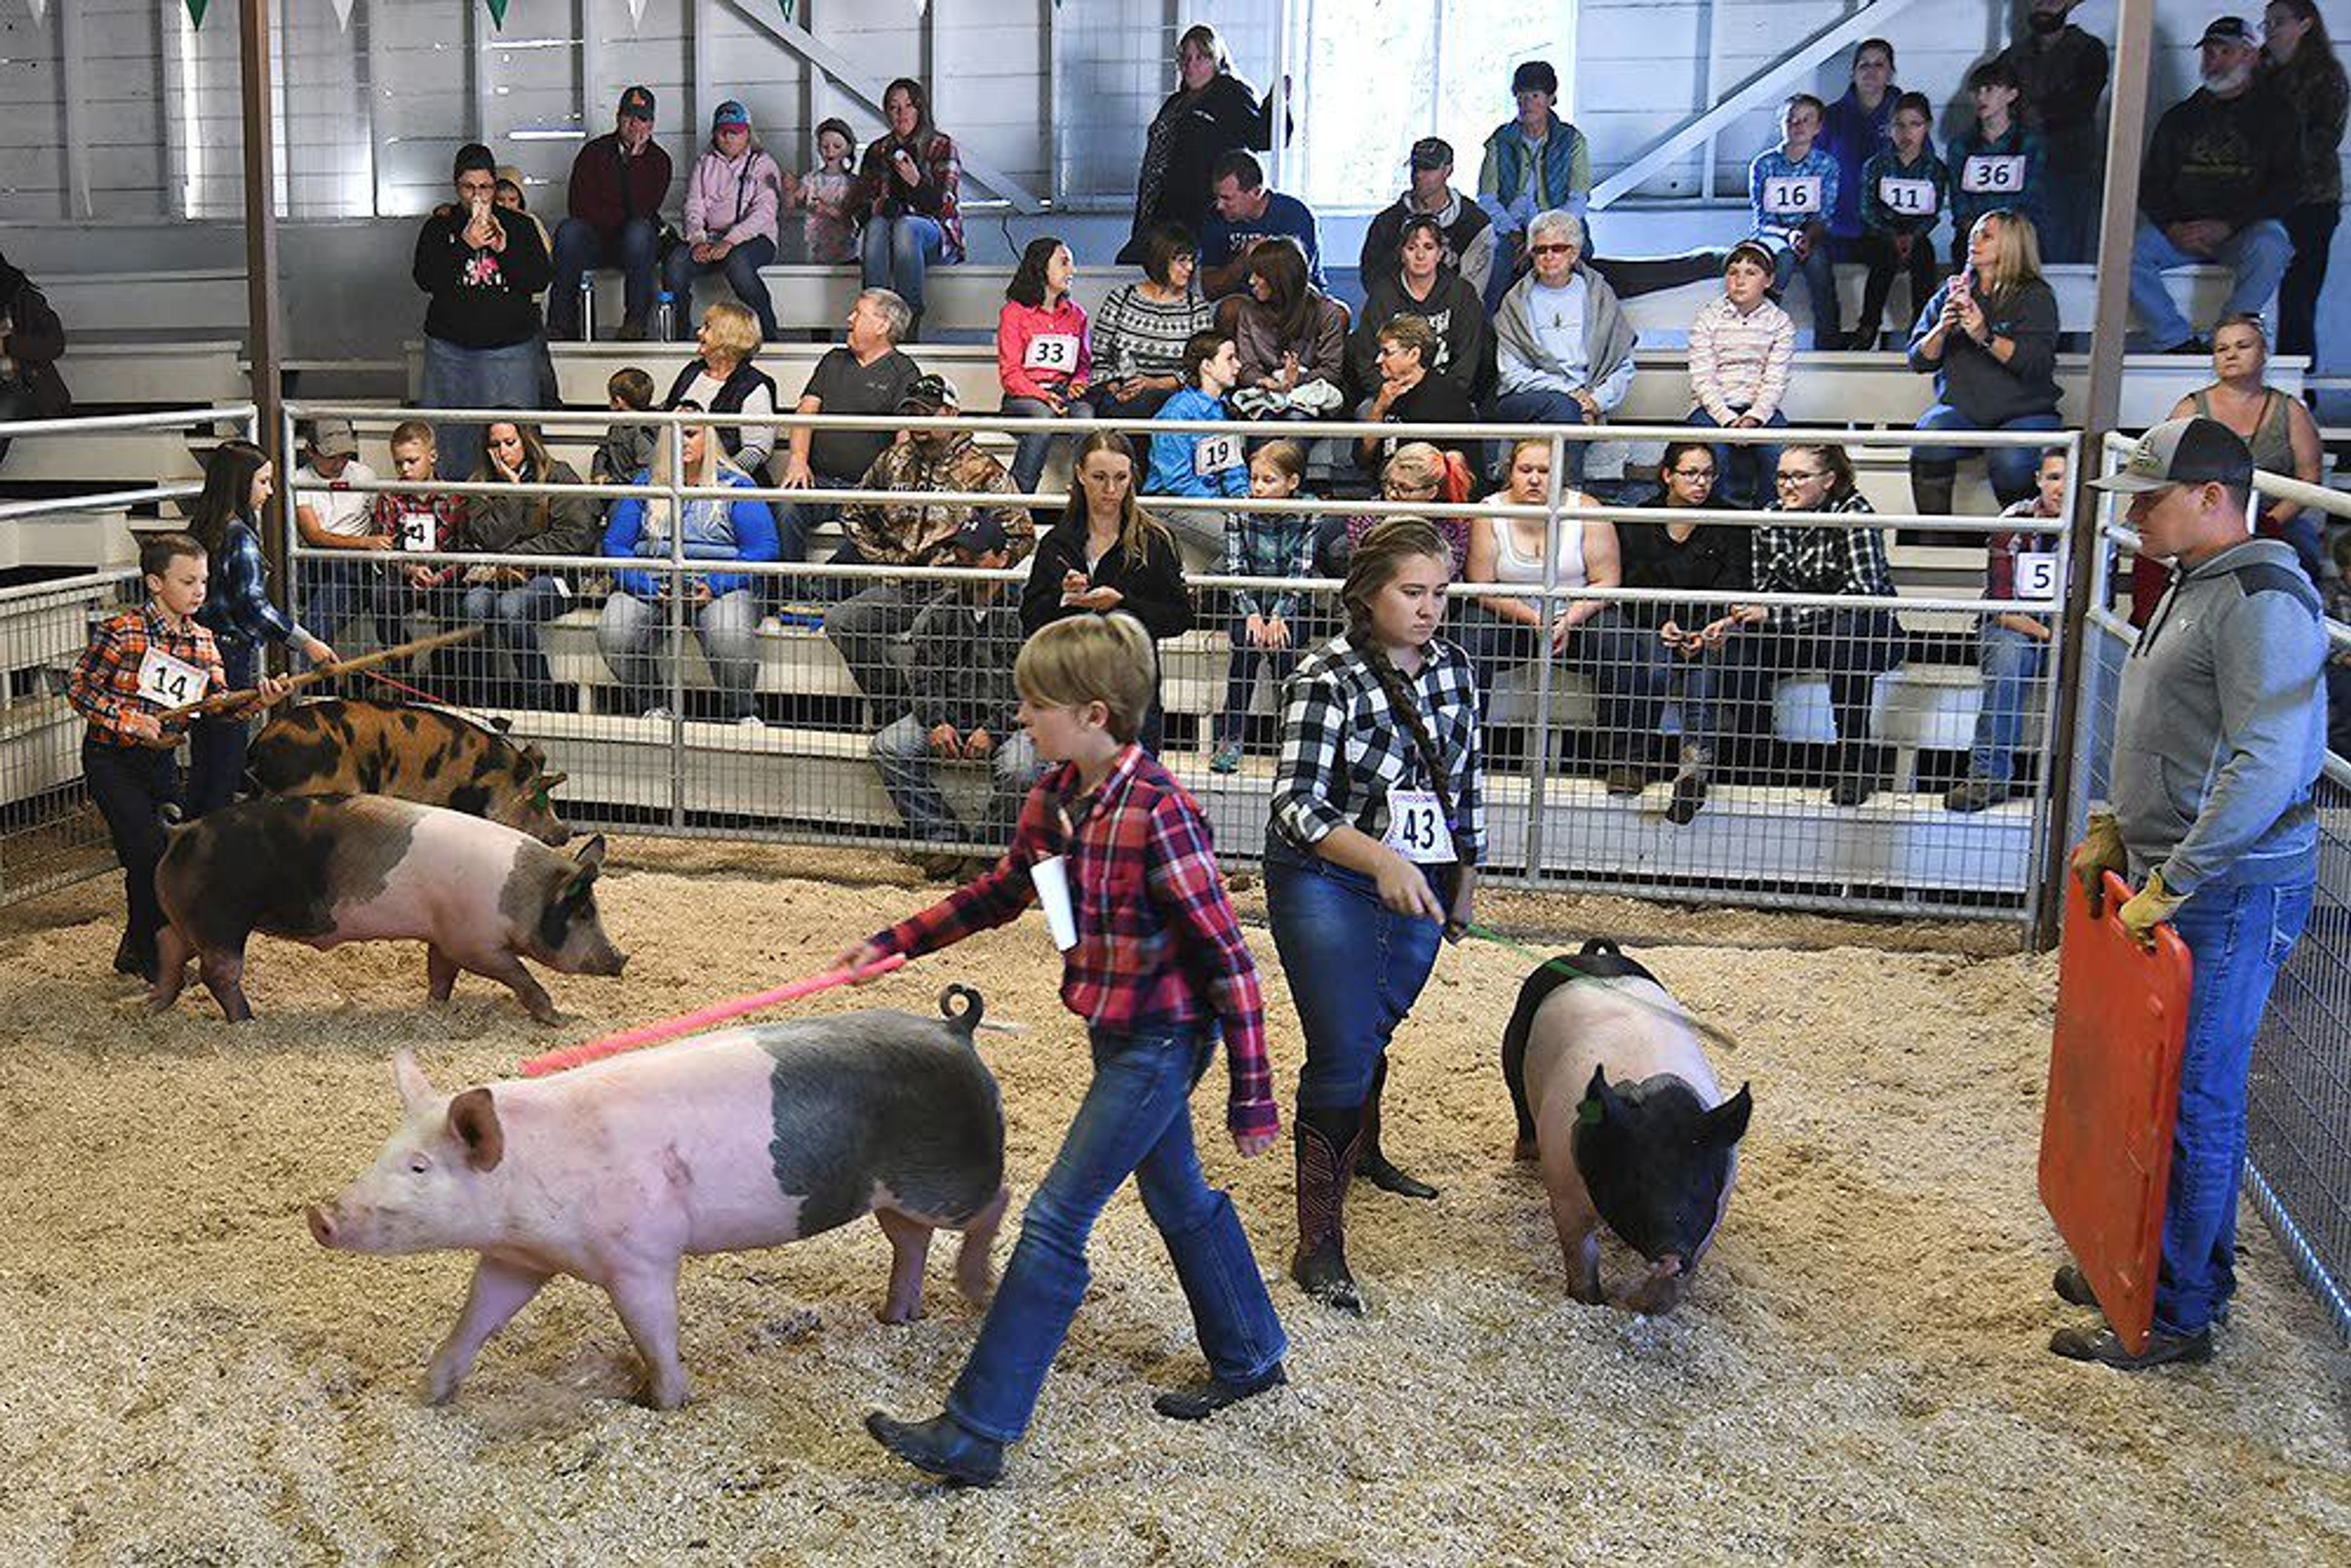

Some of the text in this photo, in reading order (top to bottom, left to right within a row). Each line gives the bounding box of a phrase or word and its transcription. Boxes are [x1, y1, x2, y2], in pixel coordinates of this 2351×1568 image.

[1976, 164, 2009, 185] 36
[1777, 185, 1807, 206] 16
[1891, 187, 1919, 209] 11
[1035, 342, 1064, 364] 33
[1205, 441, 1229, 467] 19
[2033, 563, 2050, 589] 5
[152, 666, 187, 702] 14
[1403, 808, 1435, 850] 43
